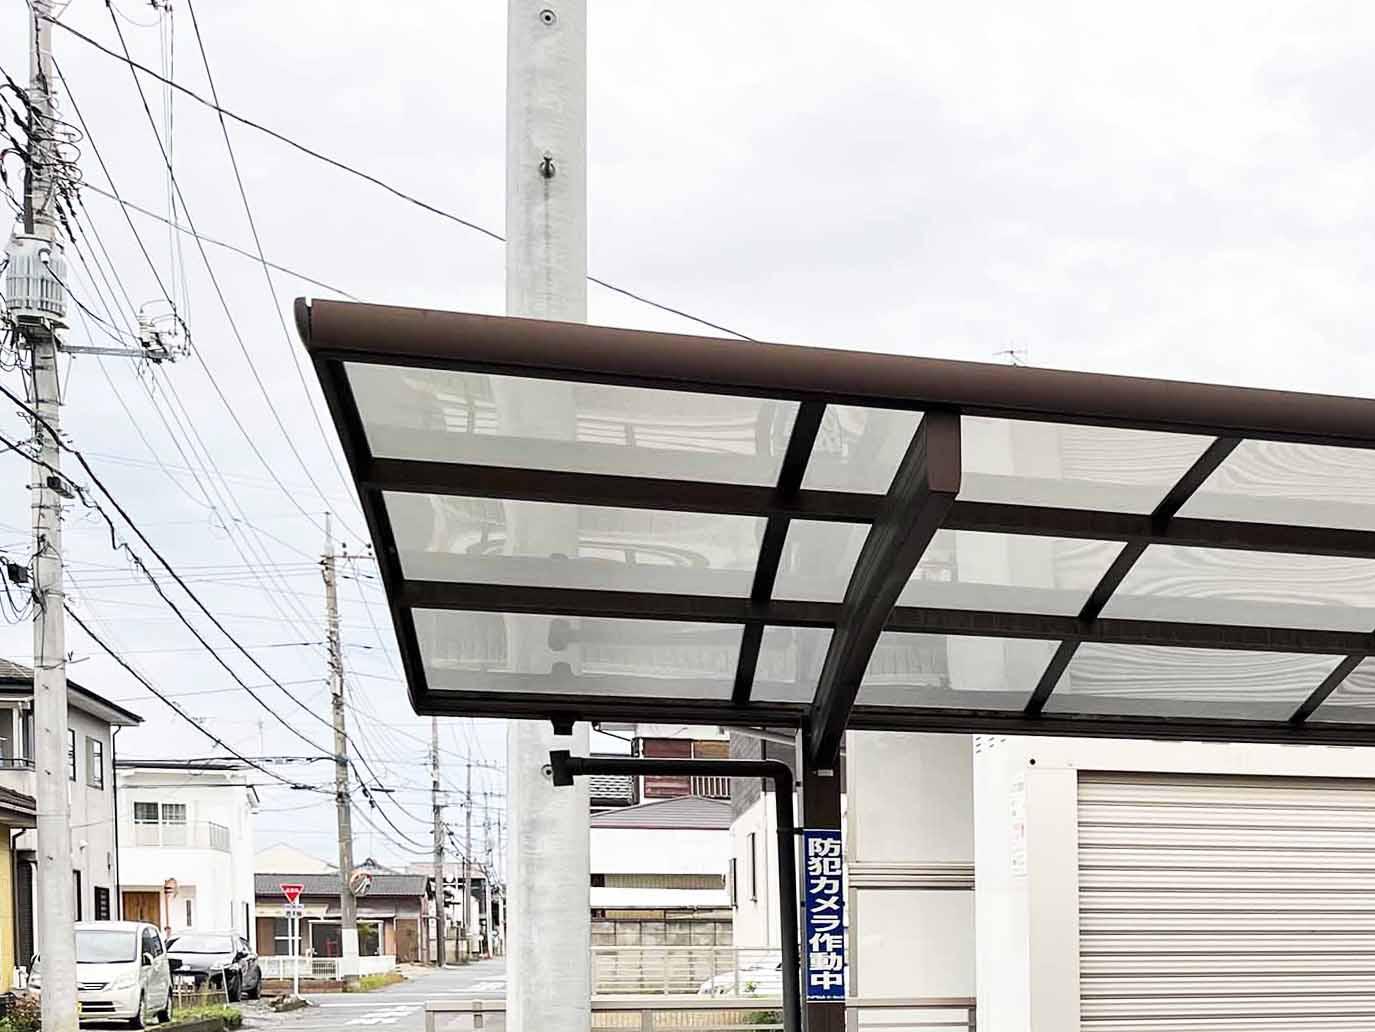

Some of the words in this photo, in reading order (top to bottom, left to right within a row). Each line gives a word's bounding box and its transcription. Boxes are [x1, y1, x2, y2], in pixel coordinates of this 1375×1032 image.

[807, 837, 843, 990] 防犯カメラ作動中
